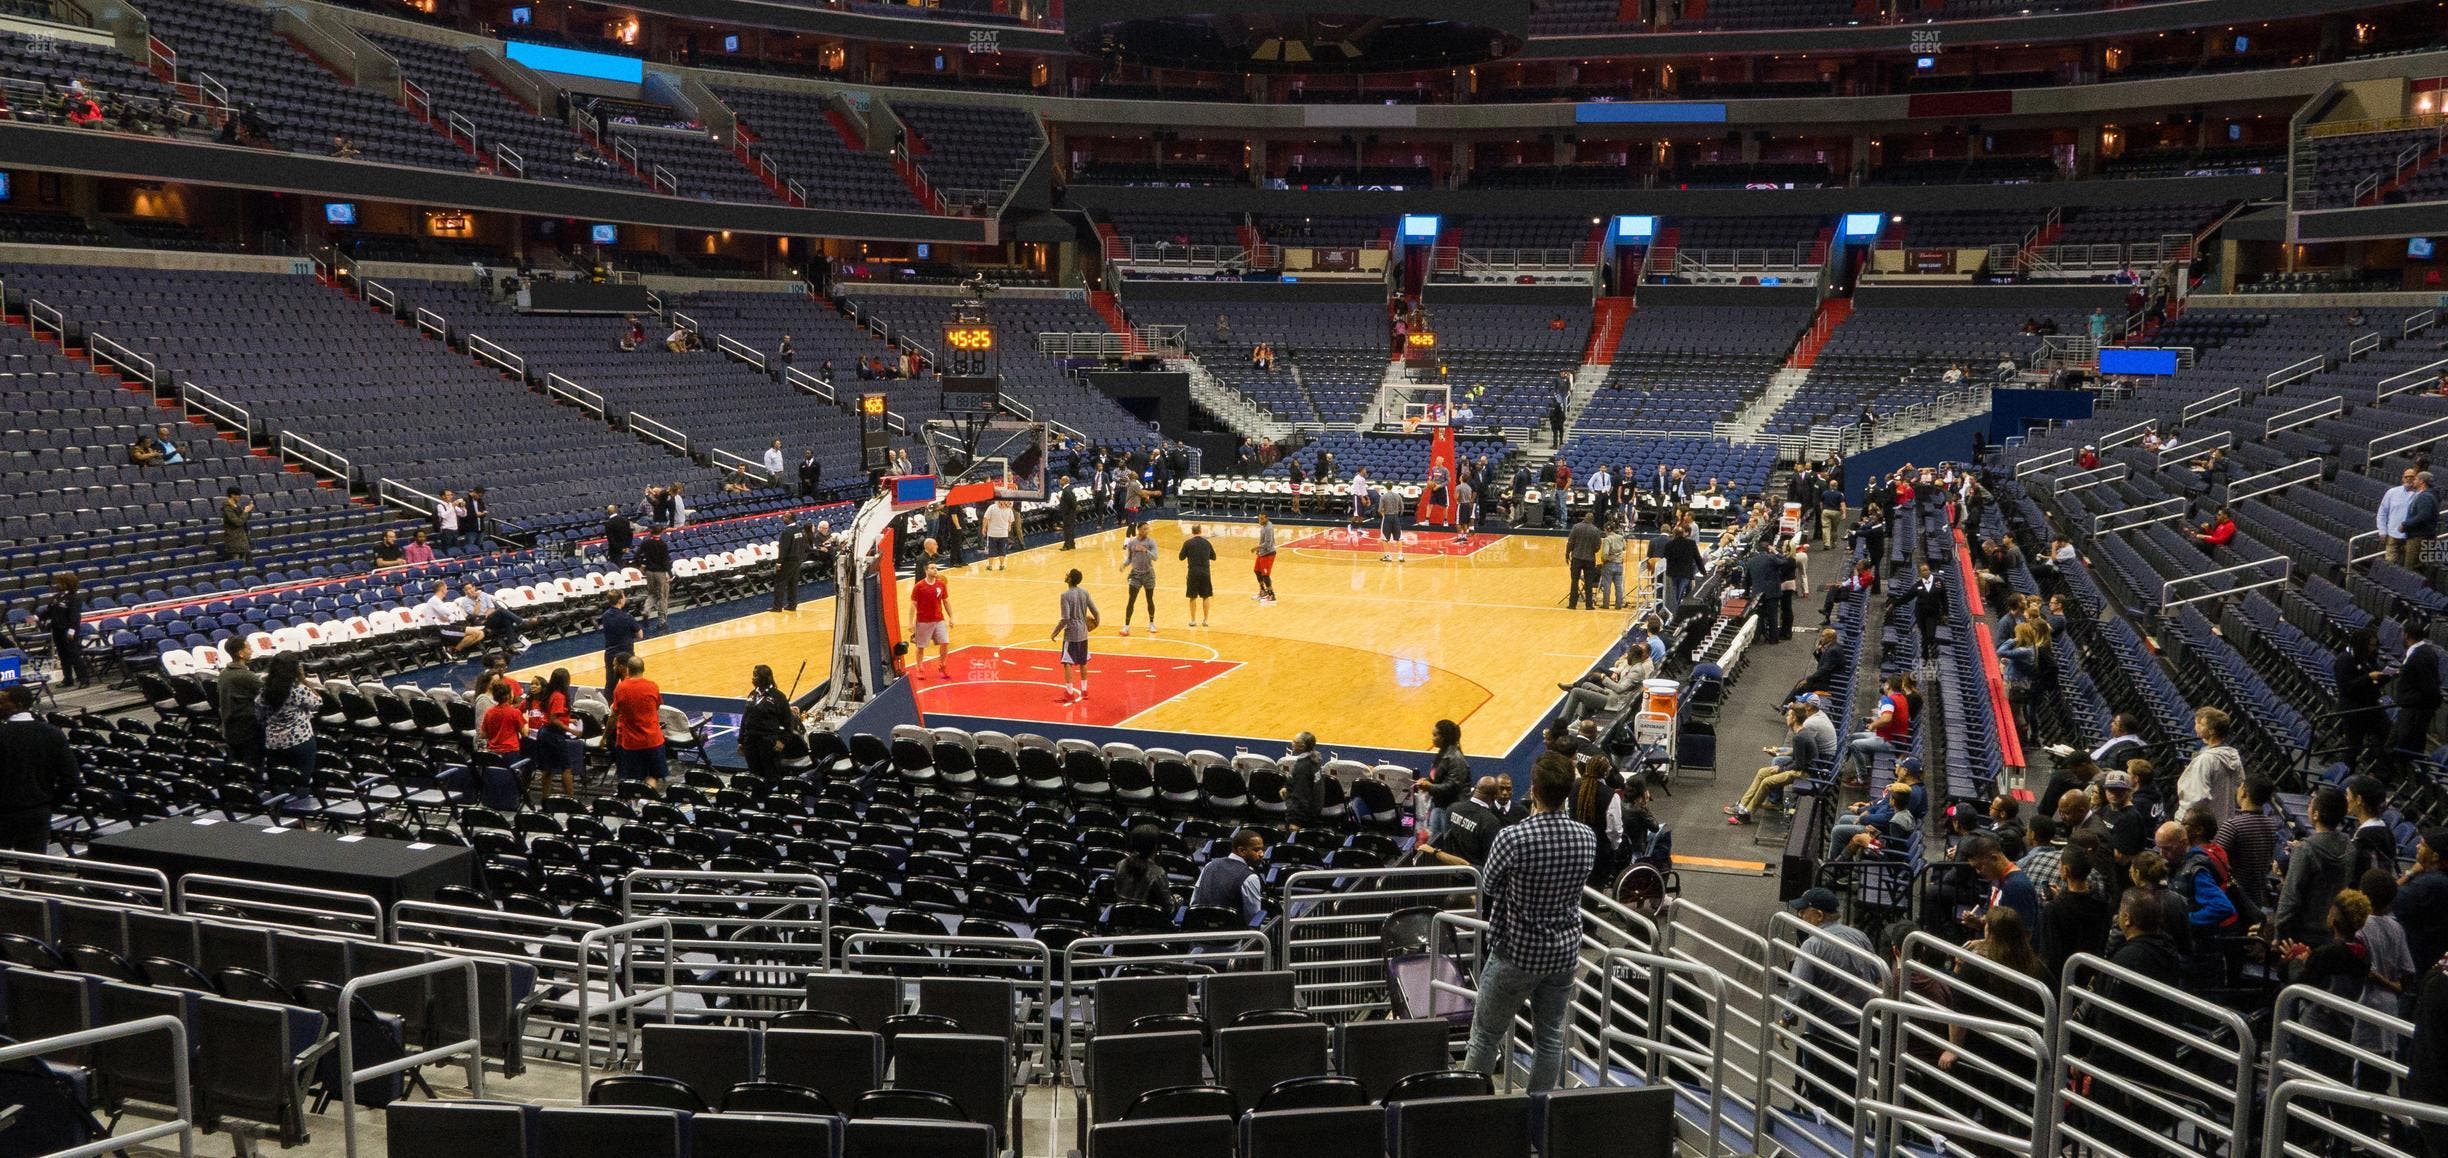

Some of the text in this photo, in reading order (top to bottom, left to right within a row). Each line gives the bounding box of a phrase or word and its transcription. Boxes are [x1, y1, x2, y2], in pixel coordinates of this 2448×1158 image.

[294, 263, 309, 274] 111
[791, 285, 804, 294] 109
[948, 330, 991, 347] 45:25
[1409, 335, 1433, 345] 45:25
[1461, 815, 1478, 832] STAFF
